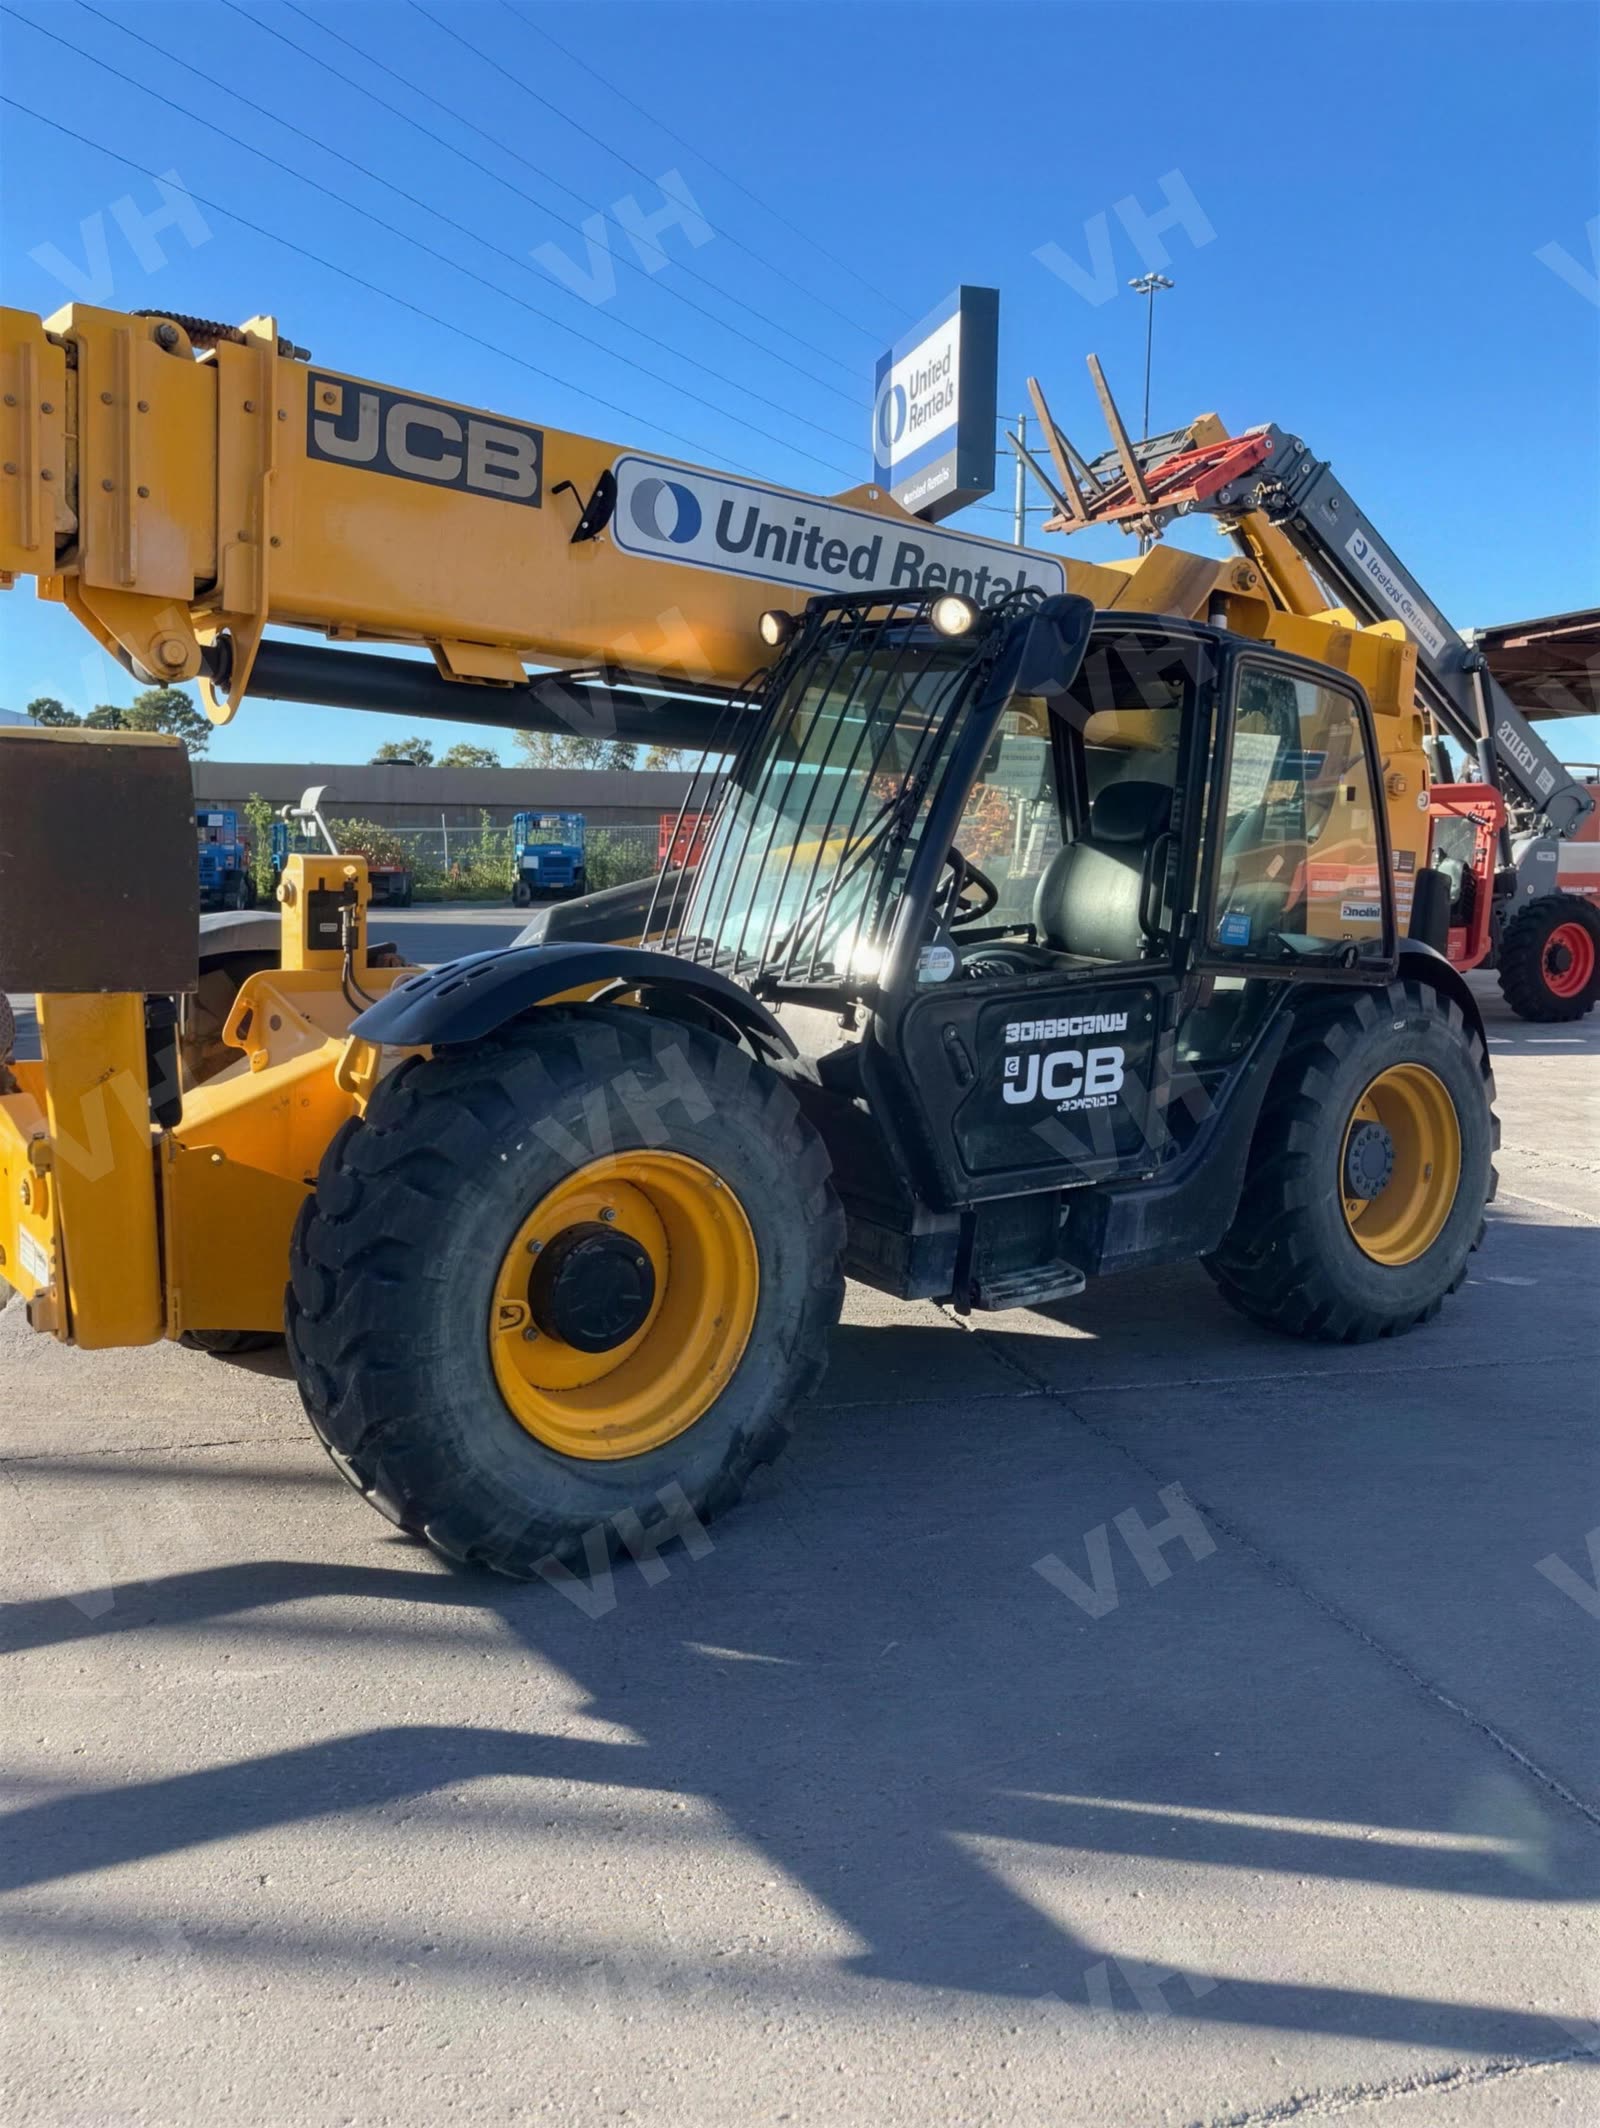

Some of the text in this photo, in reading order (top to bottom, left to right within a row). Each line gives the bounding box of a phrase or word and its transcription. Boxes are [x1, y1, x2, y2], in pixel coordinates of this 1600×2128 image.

[909, 343, 951, 401] United
[908, 377, 953, 432] Rentals
[313, 391, 538, 498] JCB
[715, 499, 1047, 608] United Rentals
[1002, 1045, 1126, 1105] JCB
